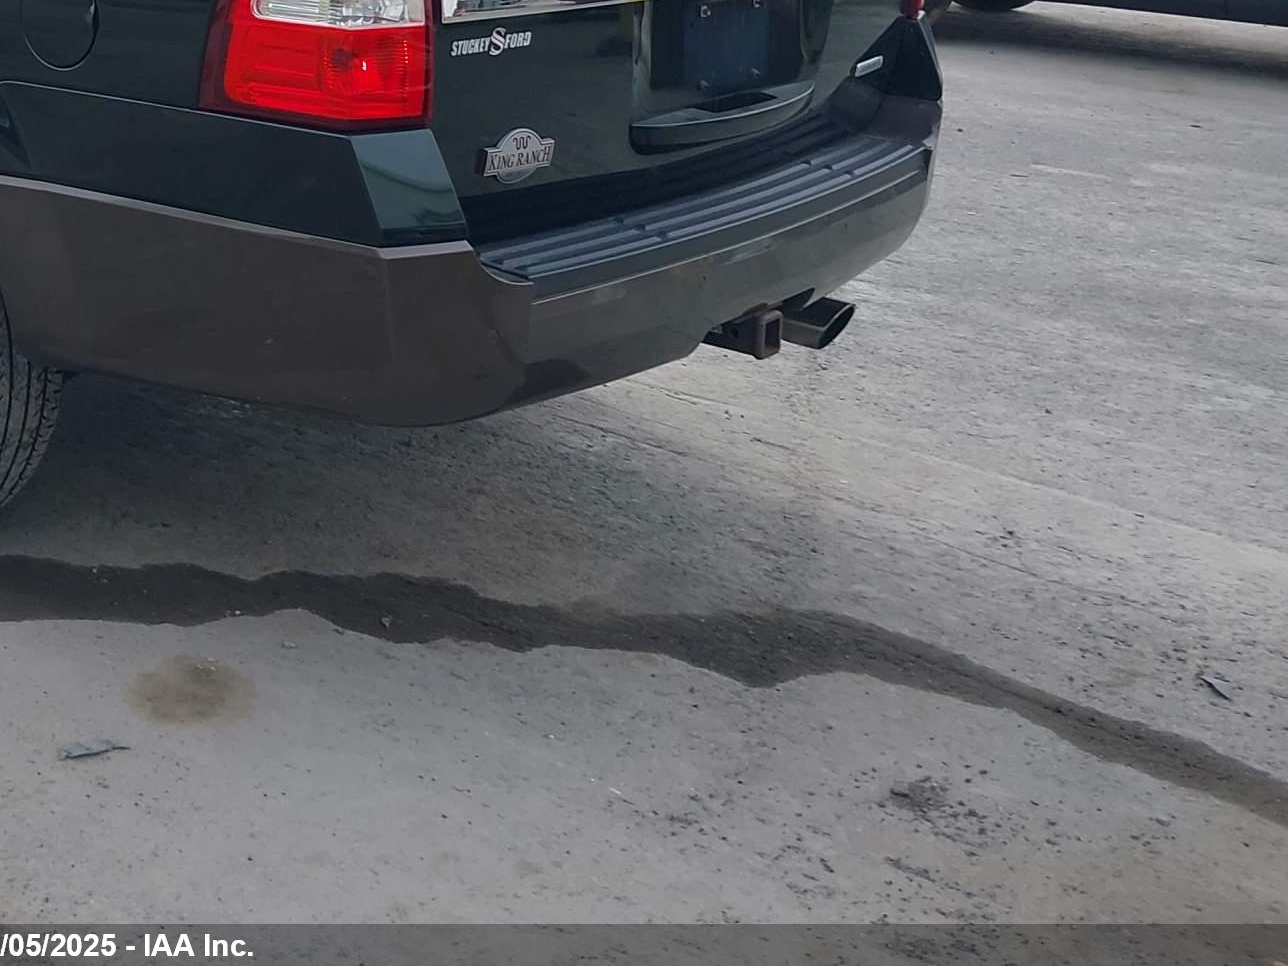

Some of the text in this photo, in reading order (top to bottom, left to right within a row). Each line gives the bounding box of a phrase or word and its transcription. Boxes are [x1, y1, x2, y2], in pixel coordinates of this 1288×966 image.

[450, 37, 492, 56] STUCKEY
[504, 31, 532, 50] FORD
[488, 145, 551, 171] KING RANCH
